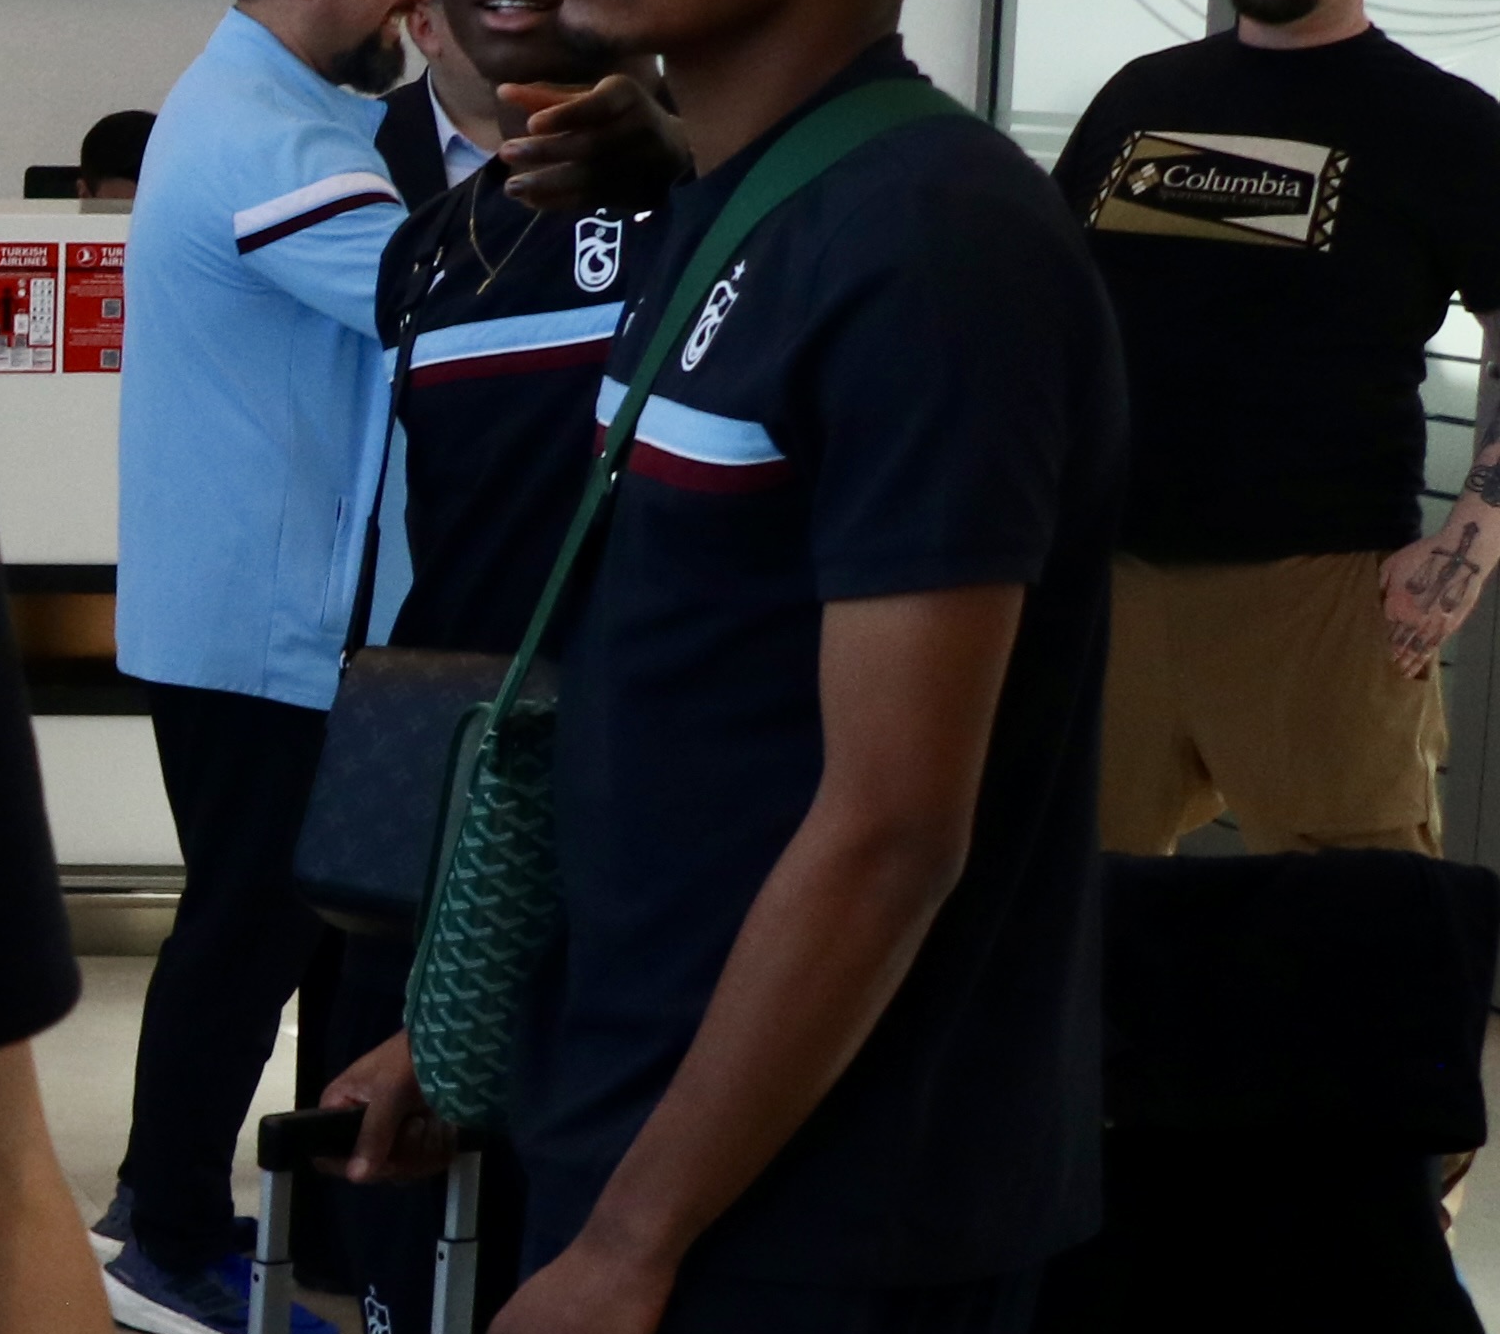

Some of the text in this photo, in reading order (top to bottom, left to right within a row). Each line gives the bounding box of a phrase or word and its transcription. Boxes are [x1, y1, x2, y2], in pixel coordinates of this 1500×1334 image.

[1162, 165, 1301, 198] Columbia
[0, 247, 48, 257] TURKISH
[0, 257, 48, 267] AIRLINES
